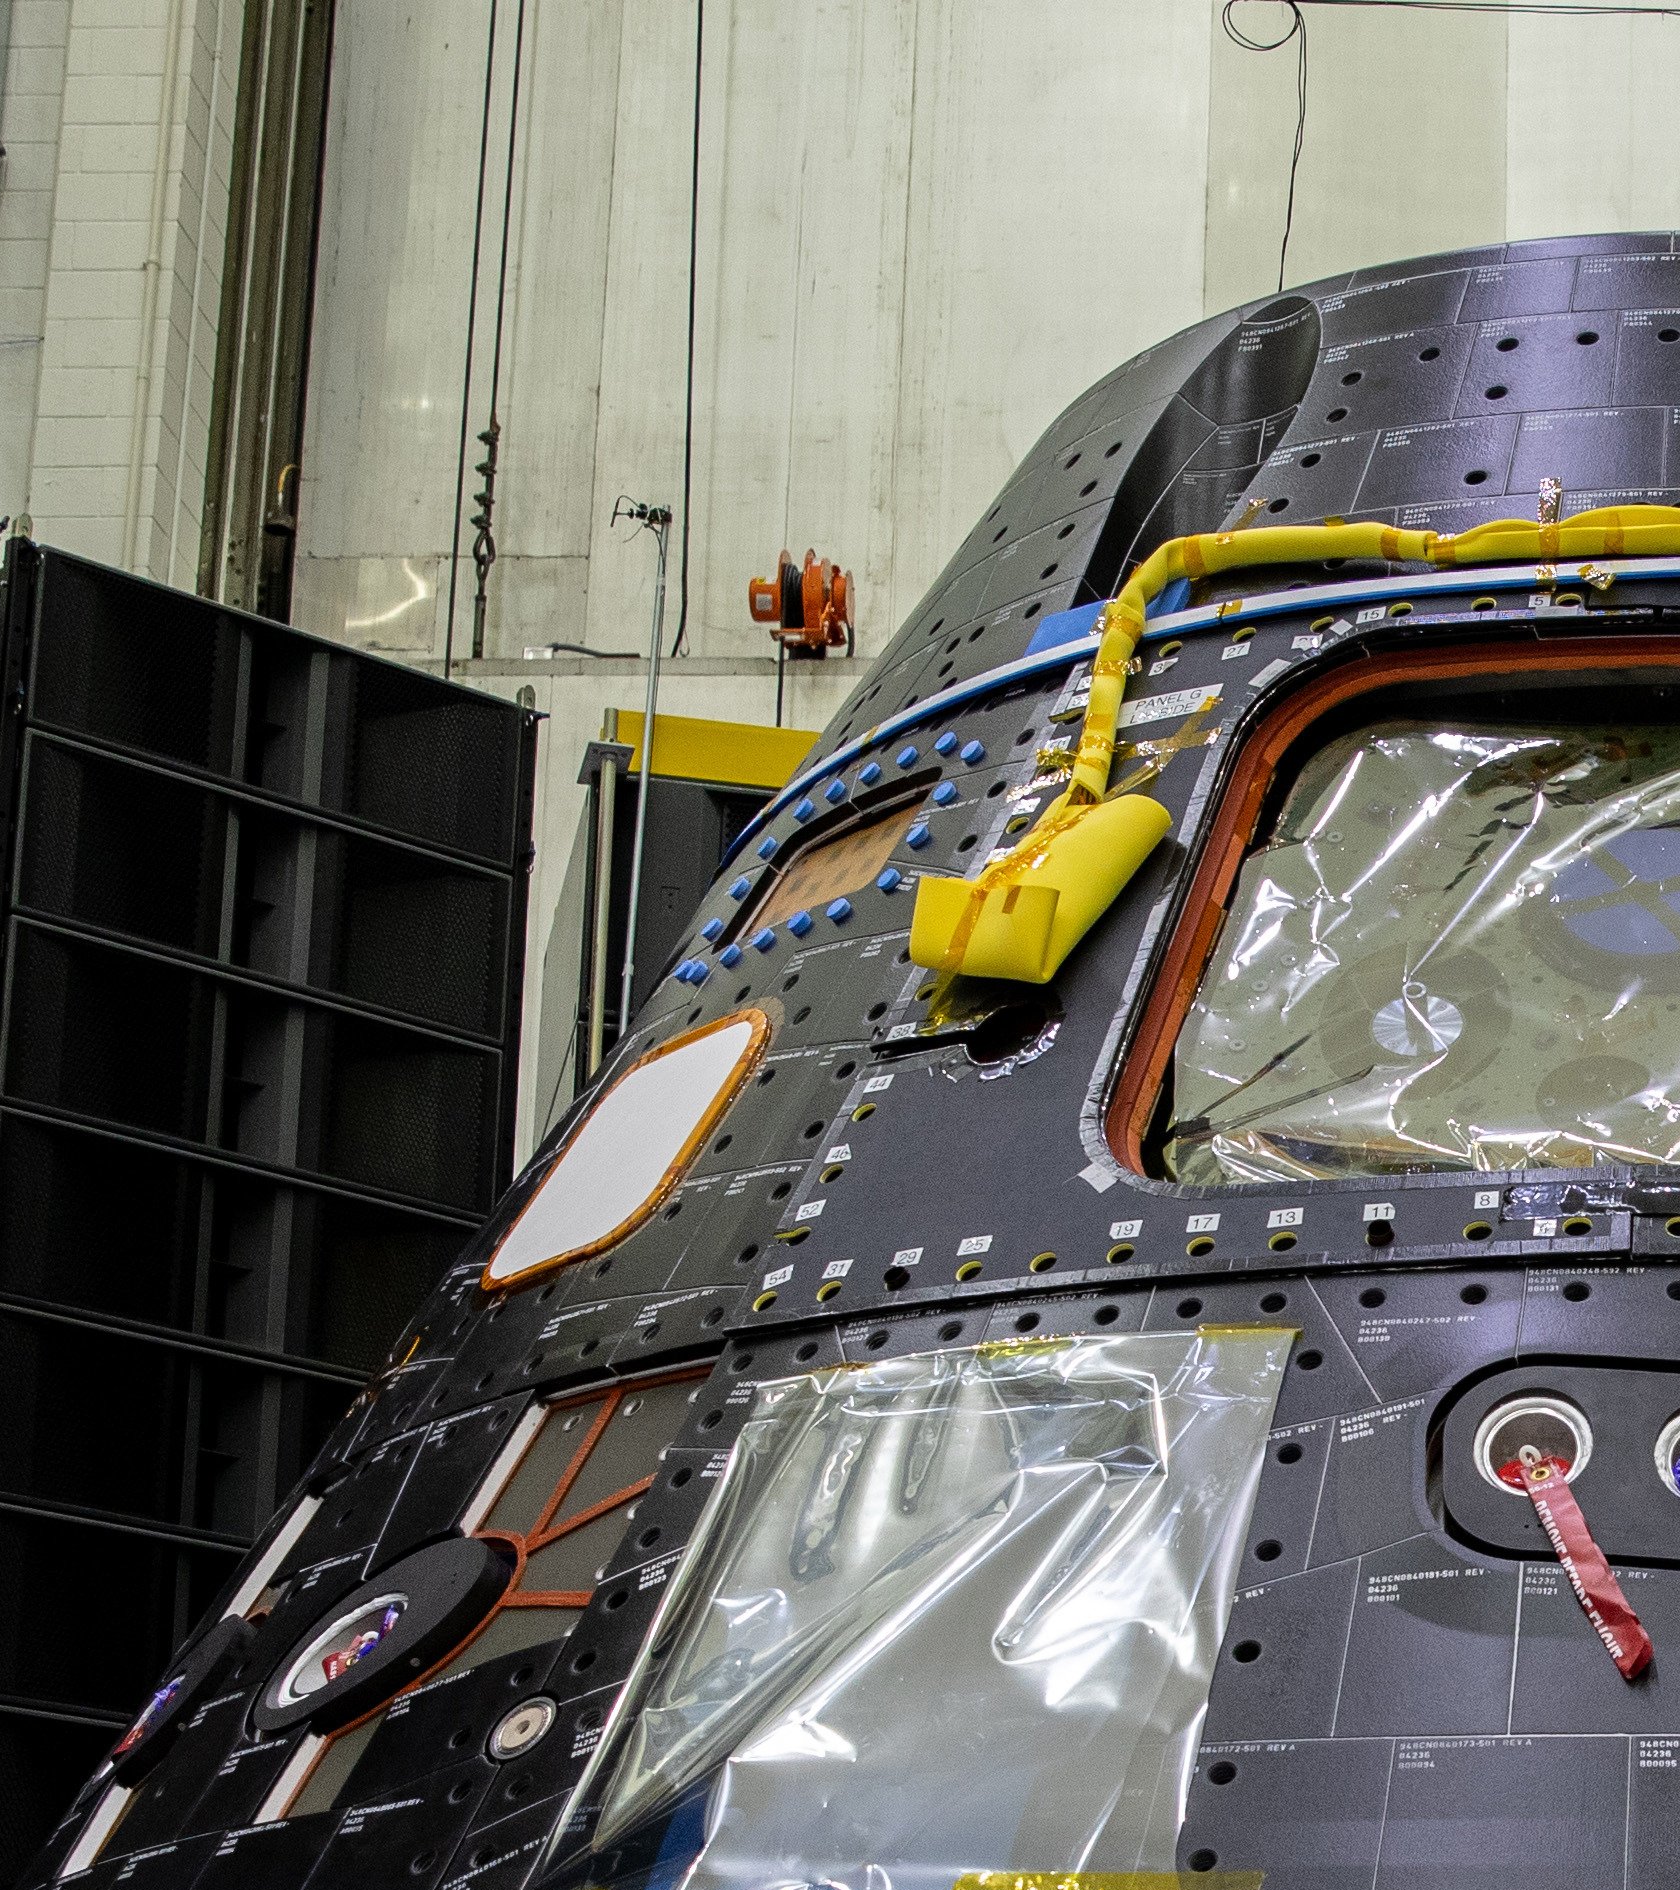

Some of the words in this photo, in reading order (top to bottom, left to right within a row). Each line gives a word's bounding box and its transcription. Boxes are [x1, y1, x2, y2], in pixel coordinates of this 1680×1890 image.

[1534, 596, 1544, 607] 5
[1362, 606, 1383, 621] 15
[1226, 645, 1246, 658] 27
[1134, 693, 1185, 711] PANEL
[1189, 689, 1202, 700] G
[891, 1025, 910, 1038] 38
[831, 1148, 848, 1160] 46
[1479, 1194, 1491, 1207] 8
[799, 1204, 819, 1218] 52
[1192, 1217, 1213, 1230] 17
[1275, 1211, 1296, 1225] 13
[1117, 1223, 1135, 1237] 19
[964, 1239, 984, 1252] 25
[896, 1251, 917, 1264] 29
[826, 1263, 845, 1276] 31
[768, 1271, 788, 1286] 54
